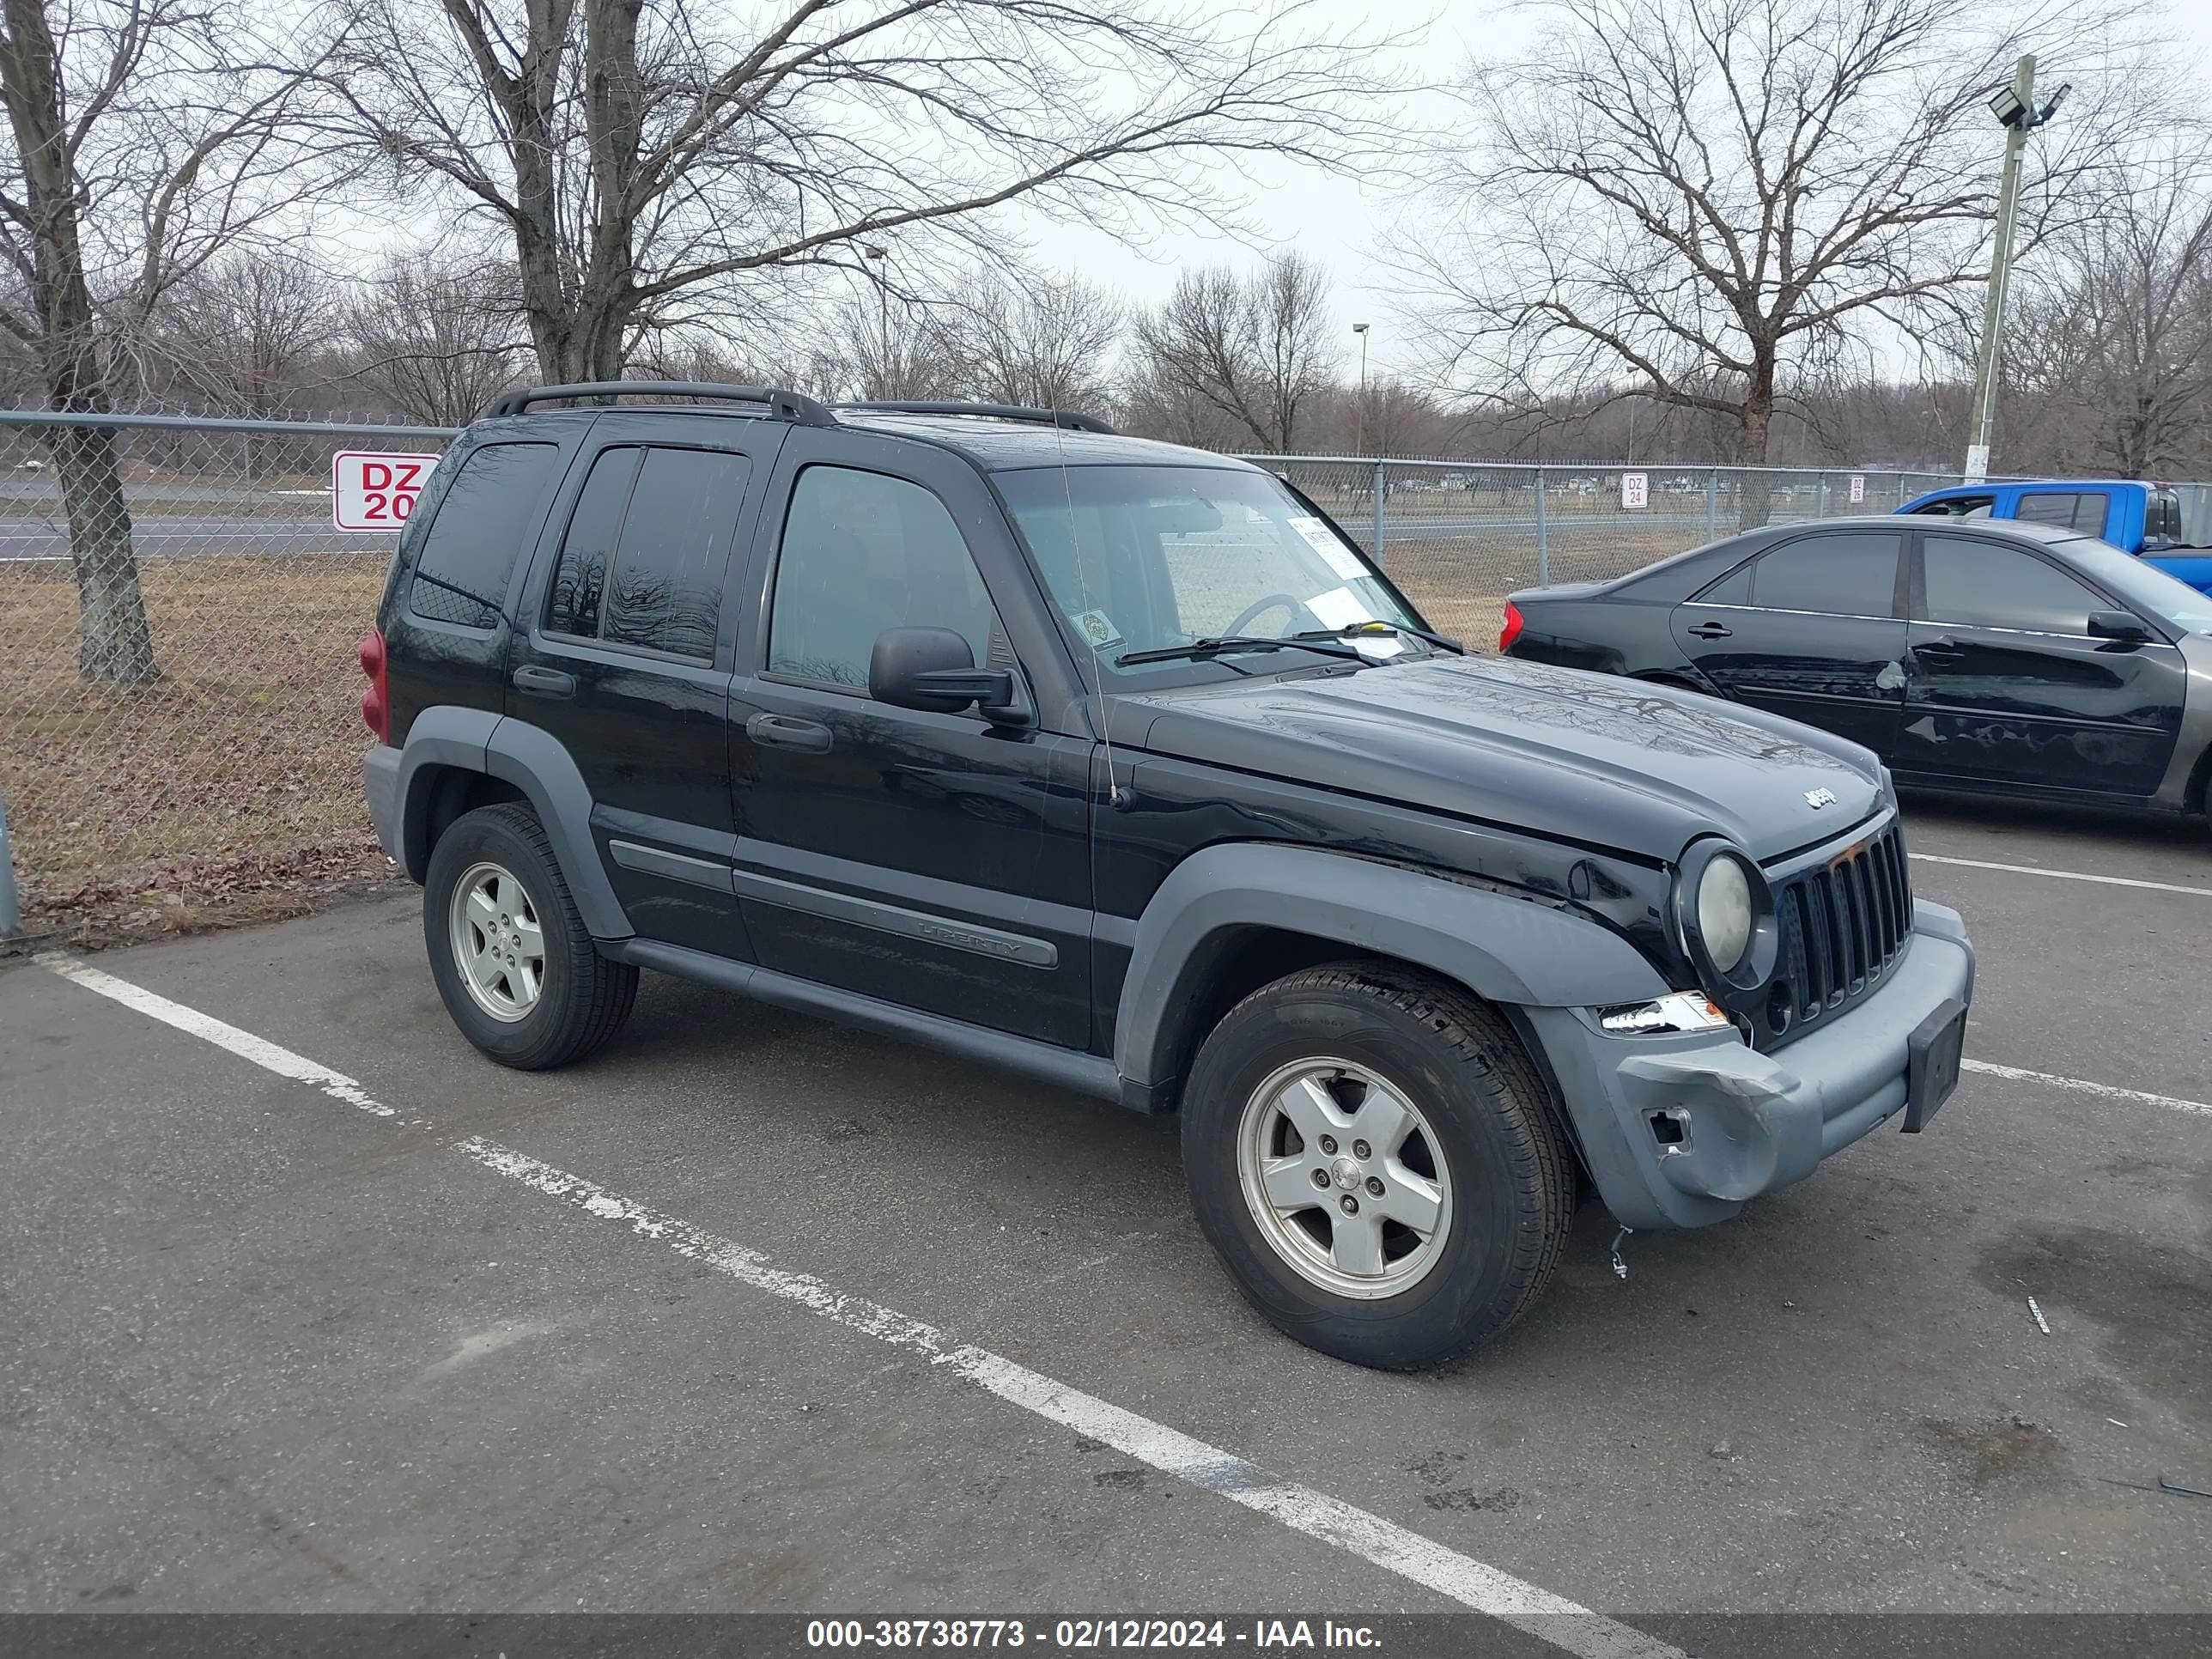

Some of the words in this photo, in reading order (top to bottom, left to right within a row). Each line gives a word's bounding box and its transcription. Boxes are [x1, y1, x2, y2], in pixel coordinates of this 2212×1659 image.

[363, 464, 421, 491] DZ
[1629, 478, 1642, 489] DZ
[364, 493, 415, 520] 20
[1630, 492, 1641, 503] 24
[1802, 786, 1837, 809] Jeep
[918, 922, 1021, 955] LIBERTY
